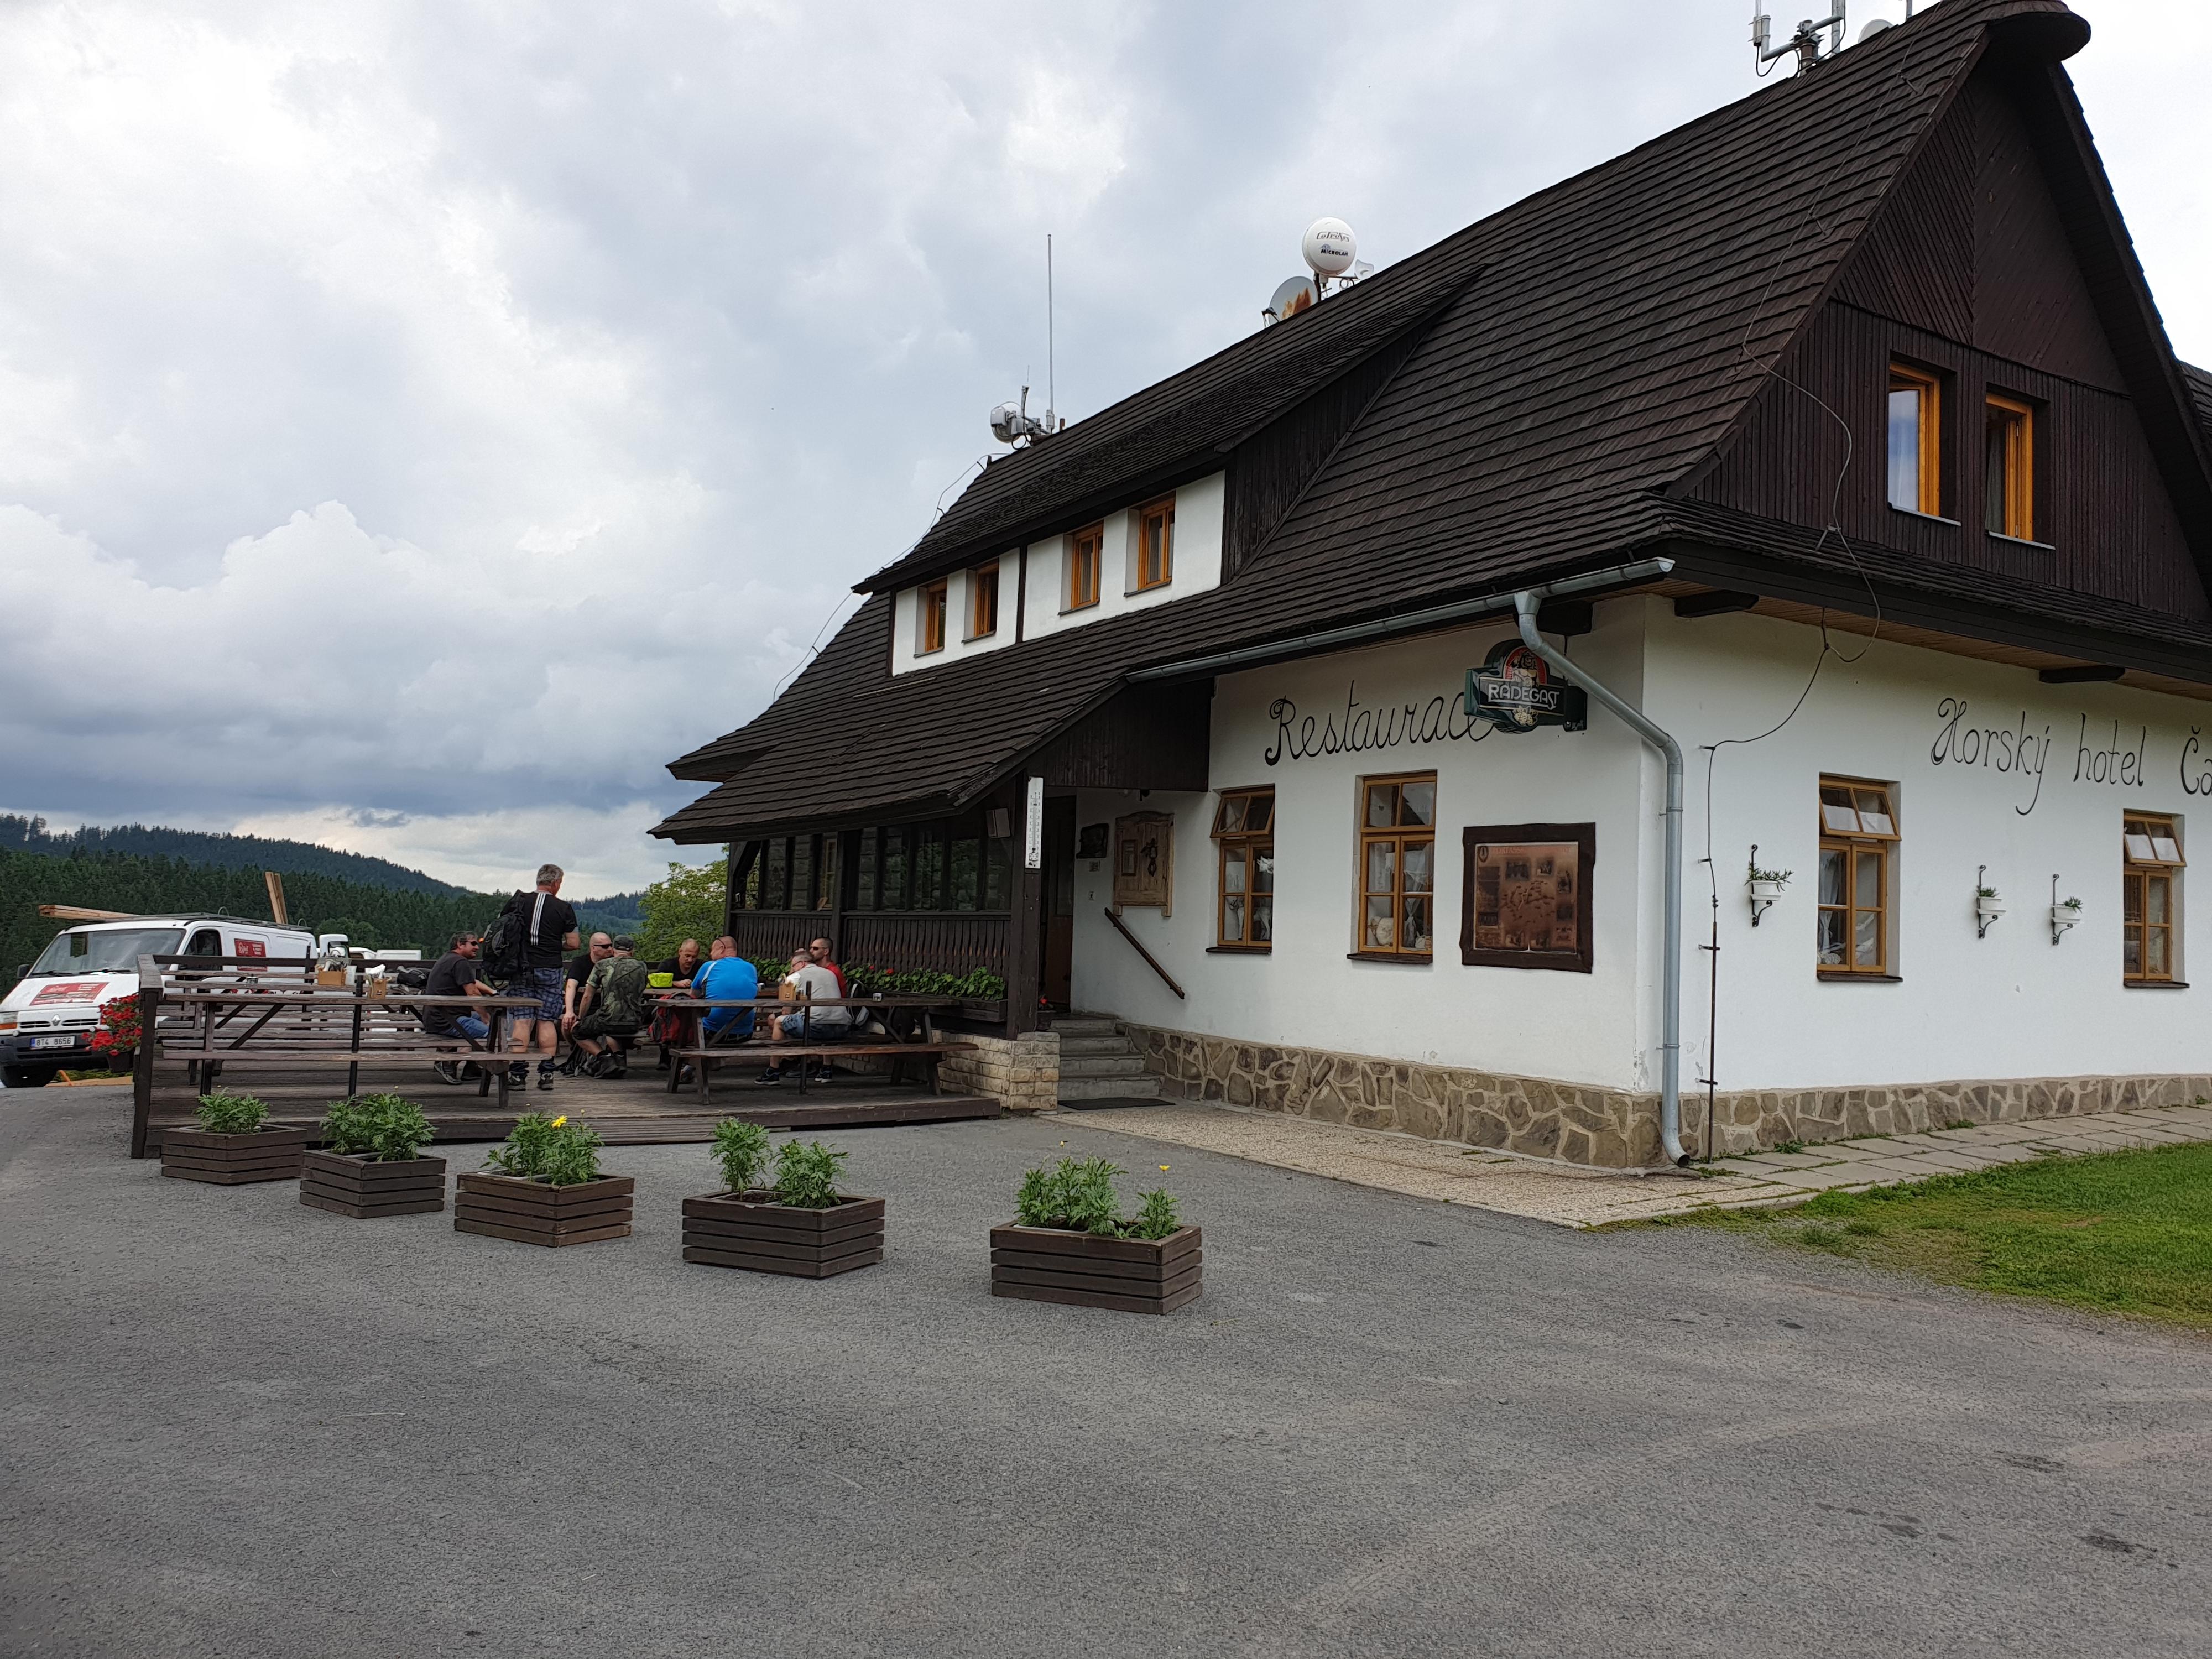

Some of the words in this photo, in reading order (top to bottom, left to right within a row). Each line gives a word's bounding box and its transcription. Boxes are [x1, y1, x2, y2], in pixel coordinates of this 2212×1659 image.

[1488, 684, 1559, 710] RADEGAST
[1931, 698, 2051, 815] Horský
[2074, 713, 2146, 787] hotel
